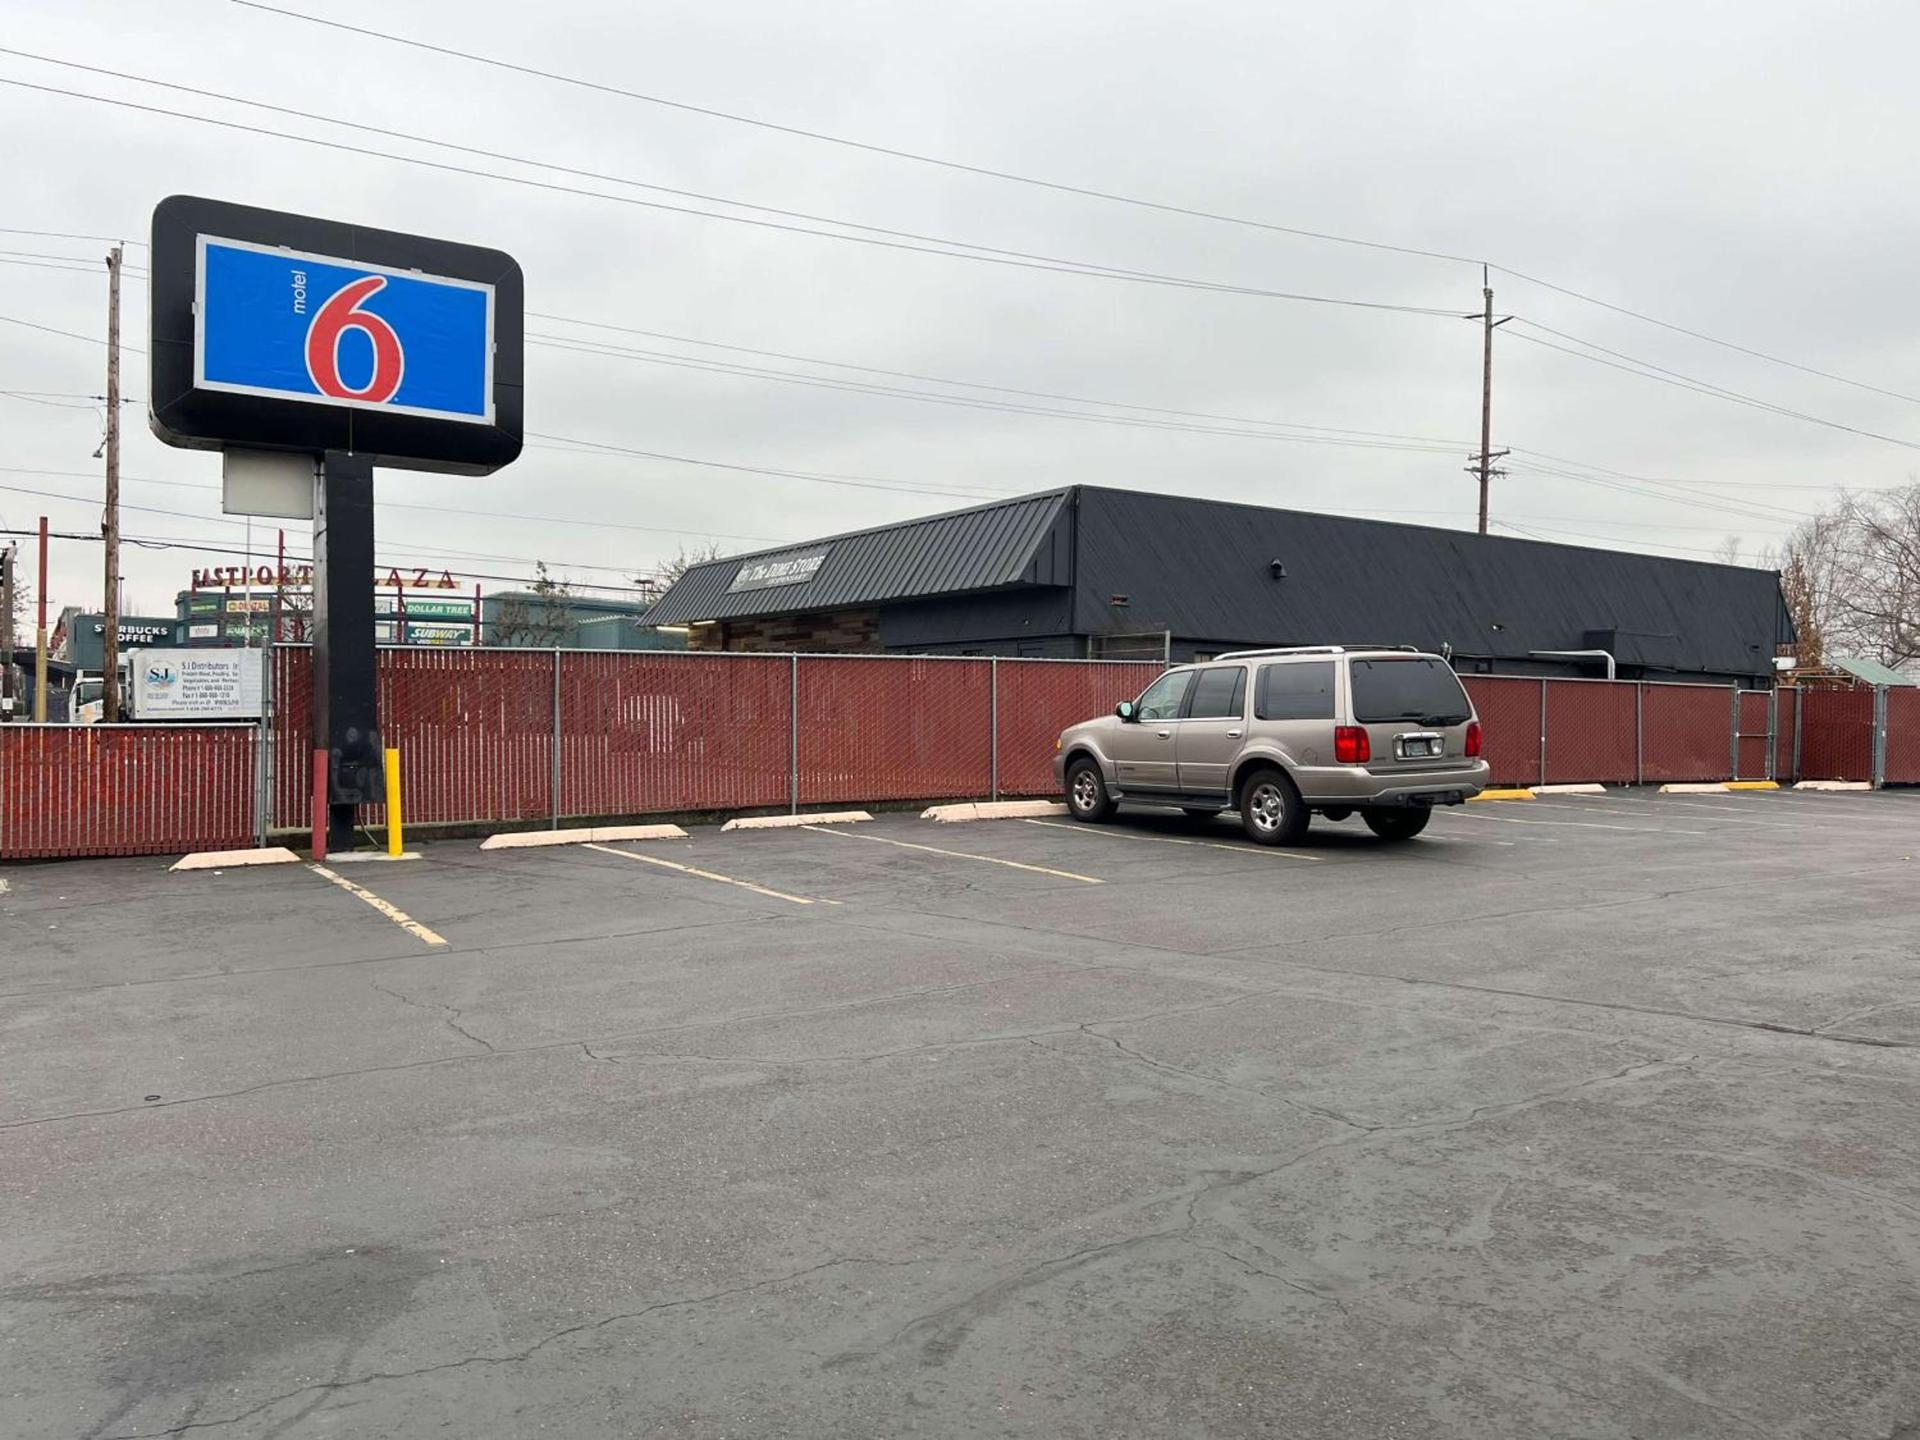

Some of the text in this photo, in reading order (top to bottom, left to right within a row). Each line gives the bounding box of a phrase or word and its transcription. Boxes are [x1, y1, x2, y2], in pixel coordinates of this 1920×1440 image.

[291, 270, 307, 315] motel
[305, 275, 405, 404] 6
[191, 565, 456, 589] EASTPORT AZA
[407, 604, 470, 615] DOLLAR TREE
[94, 623, 168, 636] SRBUCKS
[410, 628, 463, 640] SUBWAY
[116, 633, 154, 644] OFFEE
[191, 661, 229, 670] Distributors
